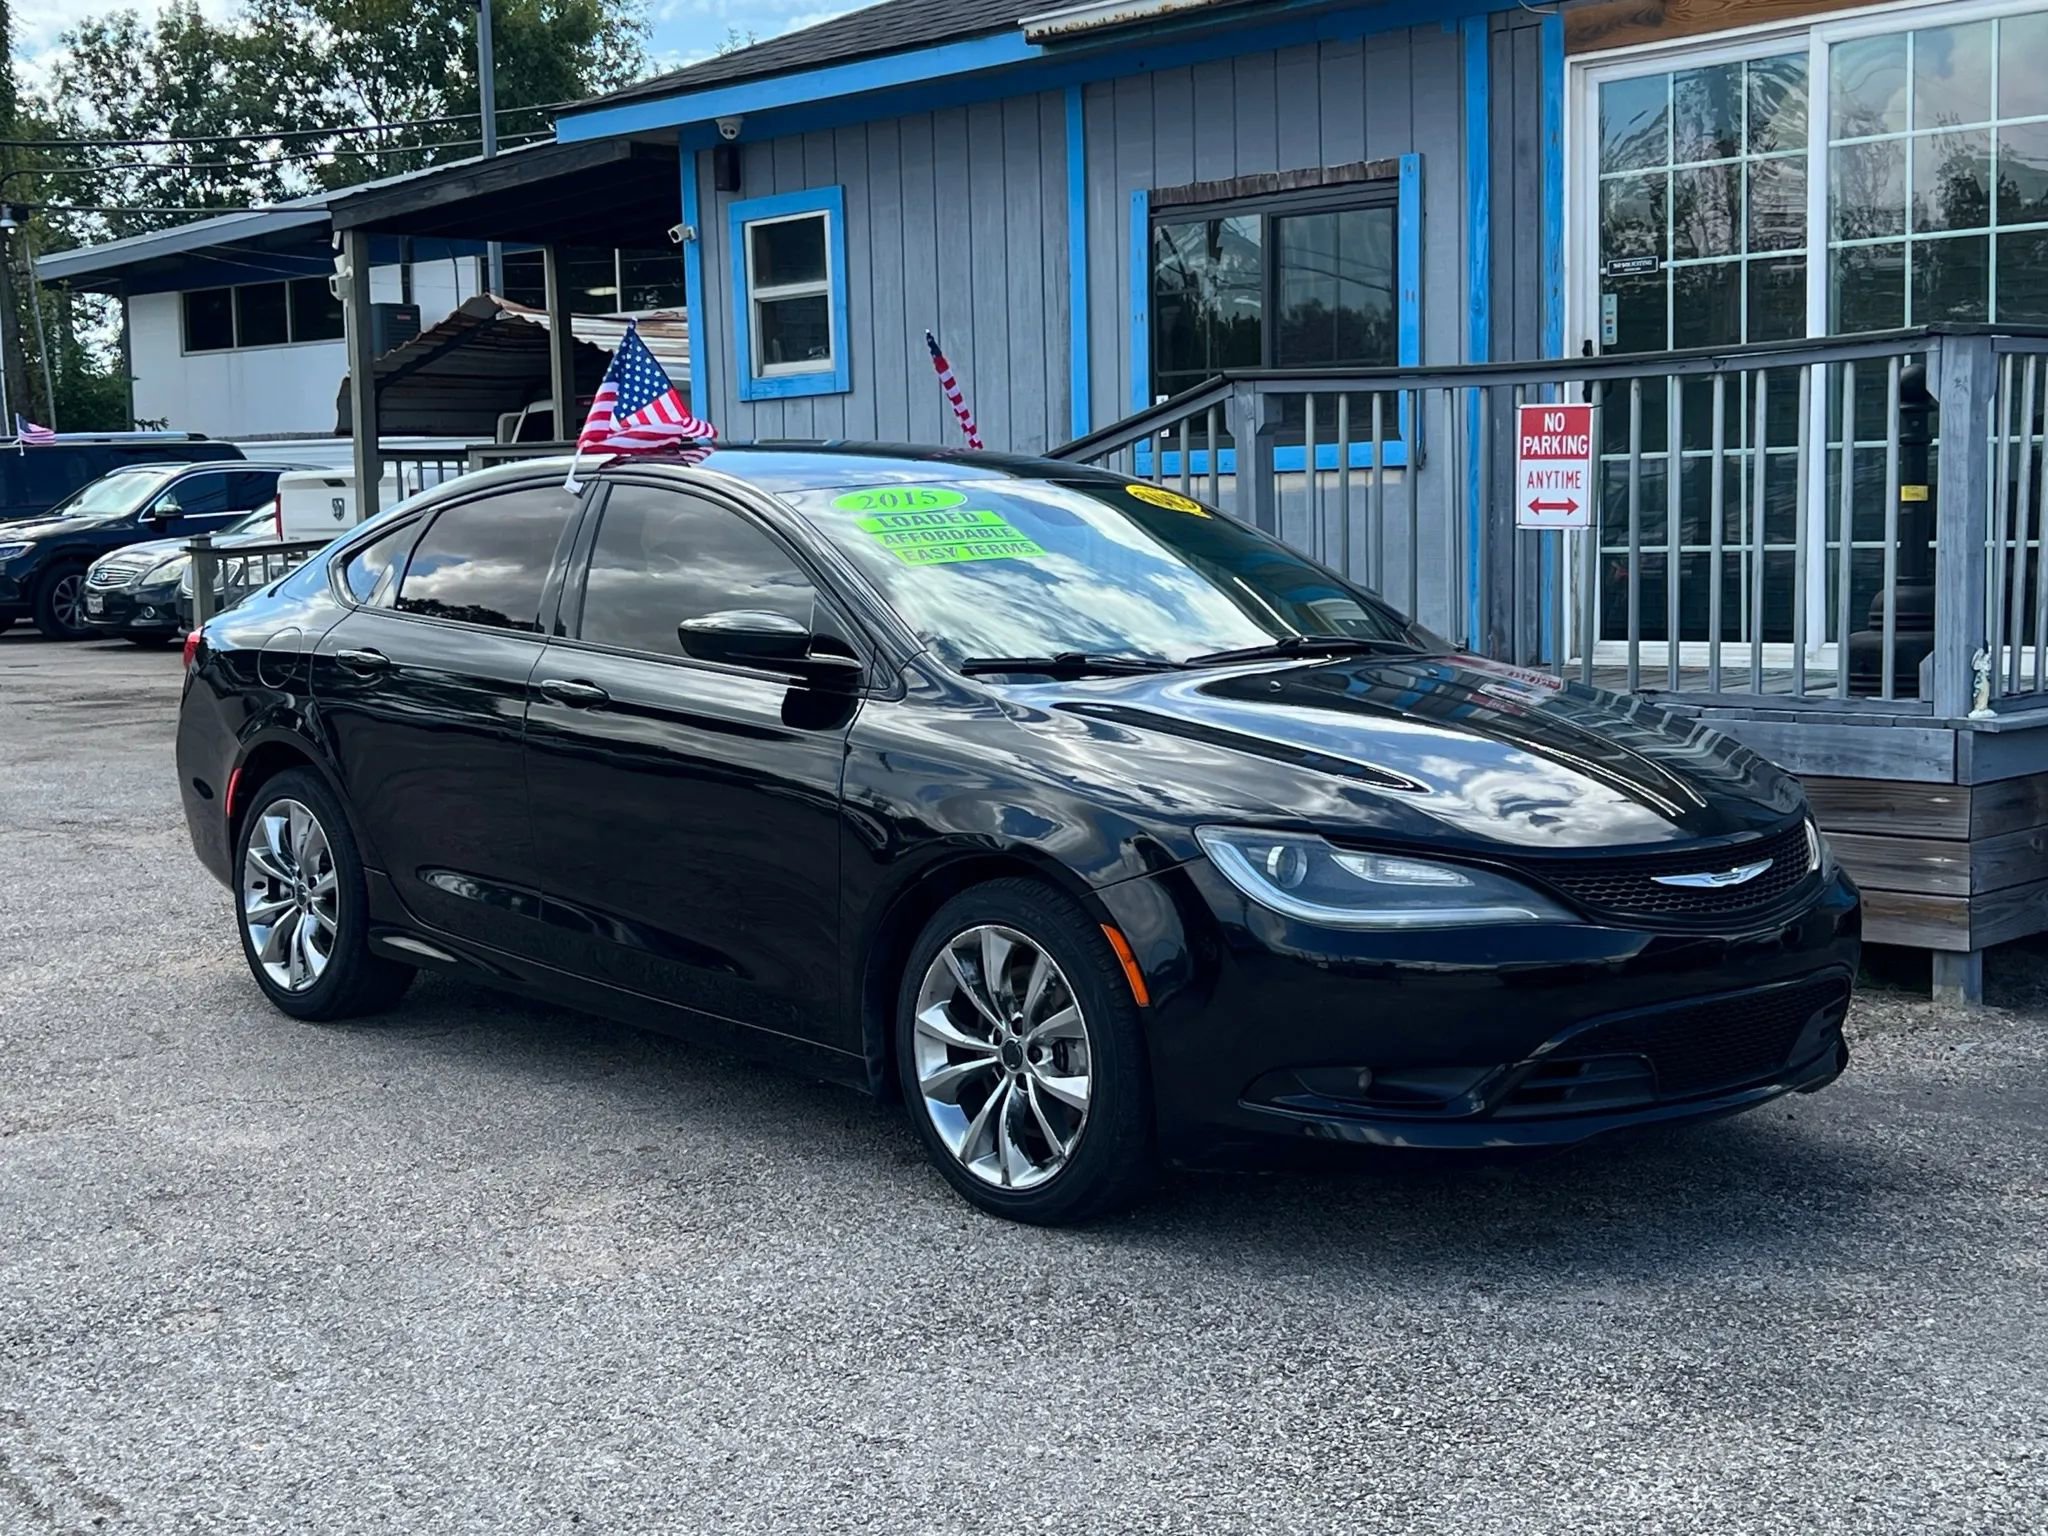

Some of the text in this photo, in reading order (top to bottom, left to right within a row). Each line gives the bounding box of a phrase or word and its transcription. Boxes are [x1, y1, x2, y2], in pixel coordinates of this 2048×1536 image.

[1544, 412, 1565, 432] NO
[1522, 435, 1588, 455] PARKING
[1527, 471, 1582, 489] ANYTIME
[858, 490, 938, 510] 2015
[877, 511, 979, 528] LOADED
[883, 527, 1016, 545] AFFORDABLE
[902, 542, 1037, 562] EASY TERMS
